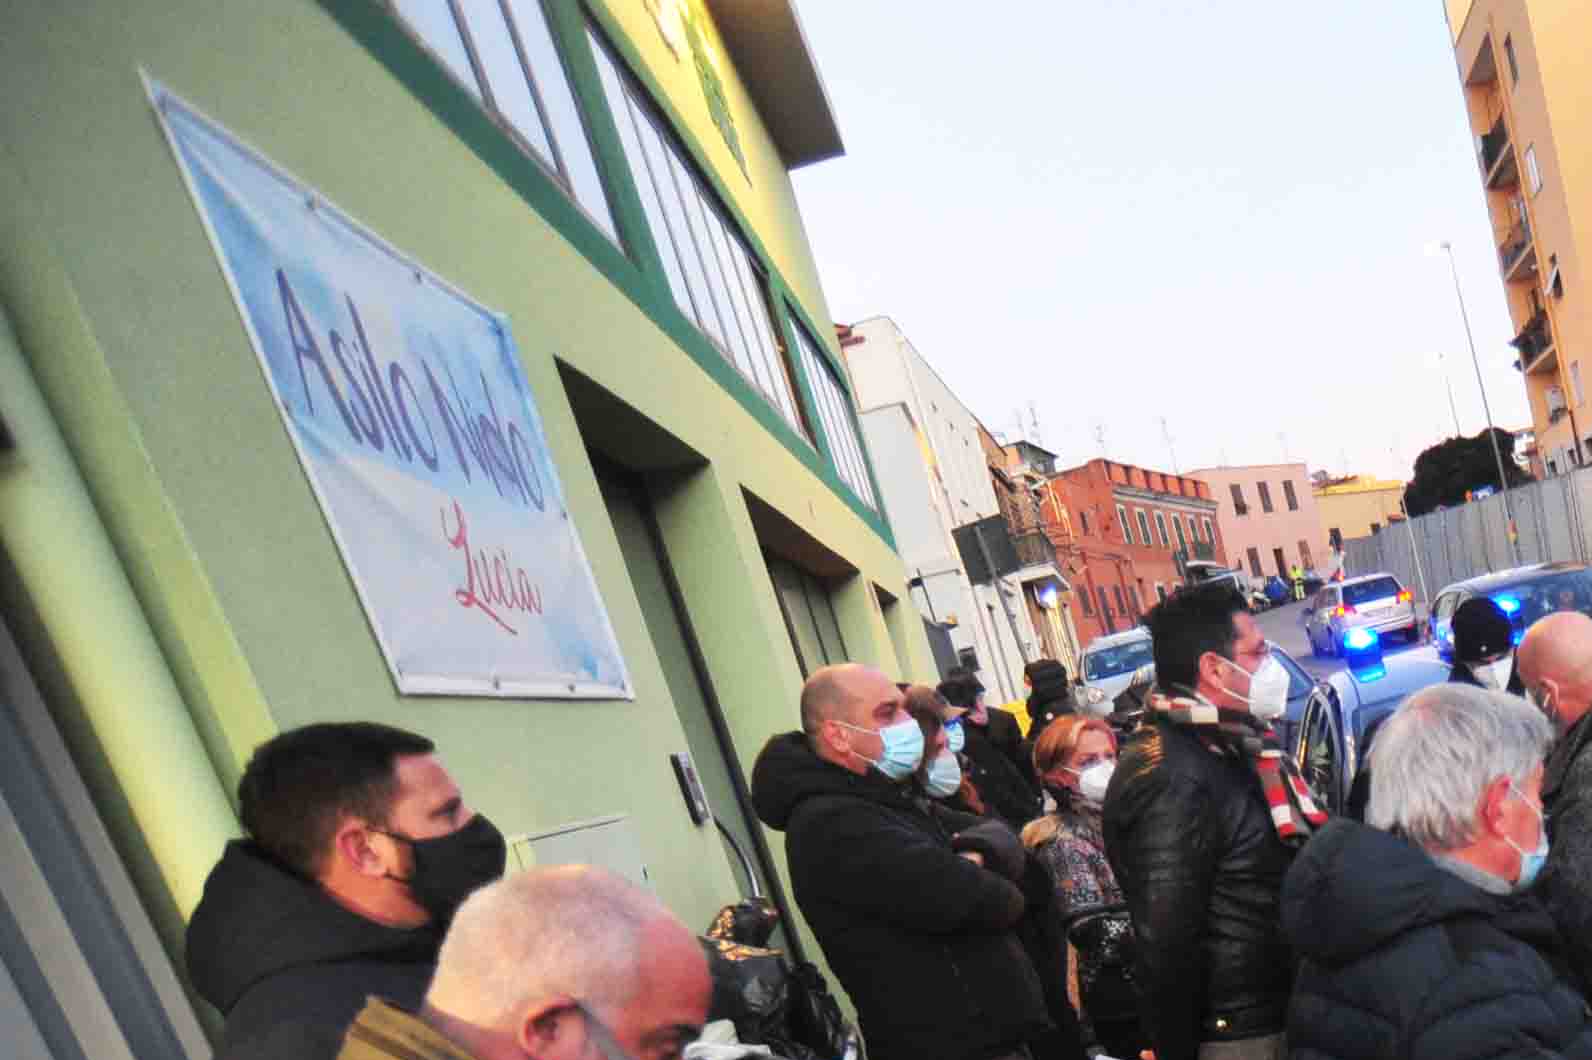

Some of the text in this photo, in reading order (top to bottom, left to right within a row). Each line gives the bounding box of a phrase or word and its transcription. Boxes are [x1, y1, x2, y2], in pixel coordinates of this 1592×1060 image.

[276, 267, 545, 512] Asilo Nido
[440, 499, 543, 635] Lucia
